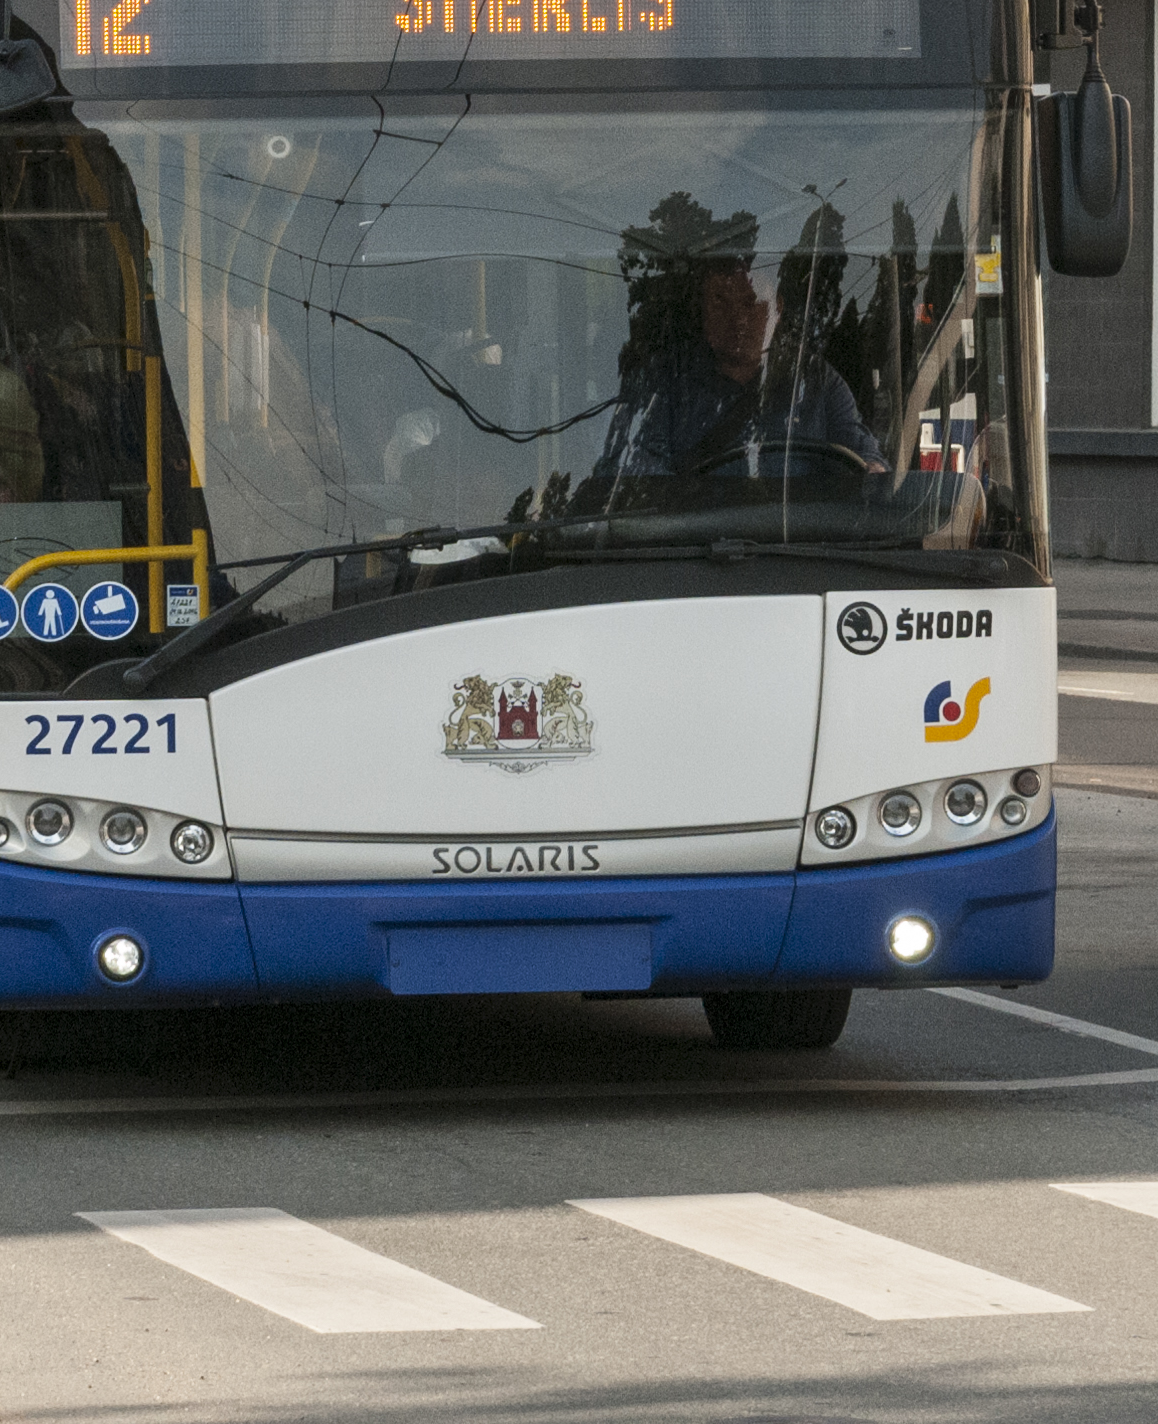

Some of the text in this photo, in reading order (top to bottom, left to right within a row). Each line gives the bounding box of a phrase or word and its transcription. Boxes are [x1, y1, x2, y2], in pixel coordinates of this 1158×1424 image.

[895, 607, 993, 642] ŠKODA
[24, 713, 176, 755] 27221
[432, 845, 600, 874] SOLARIS
